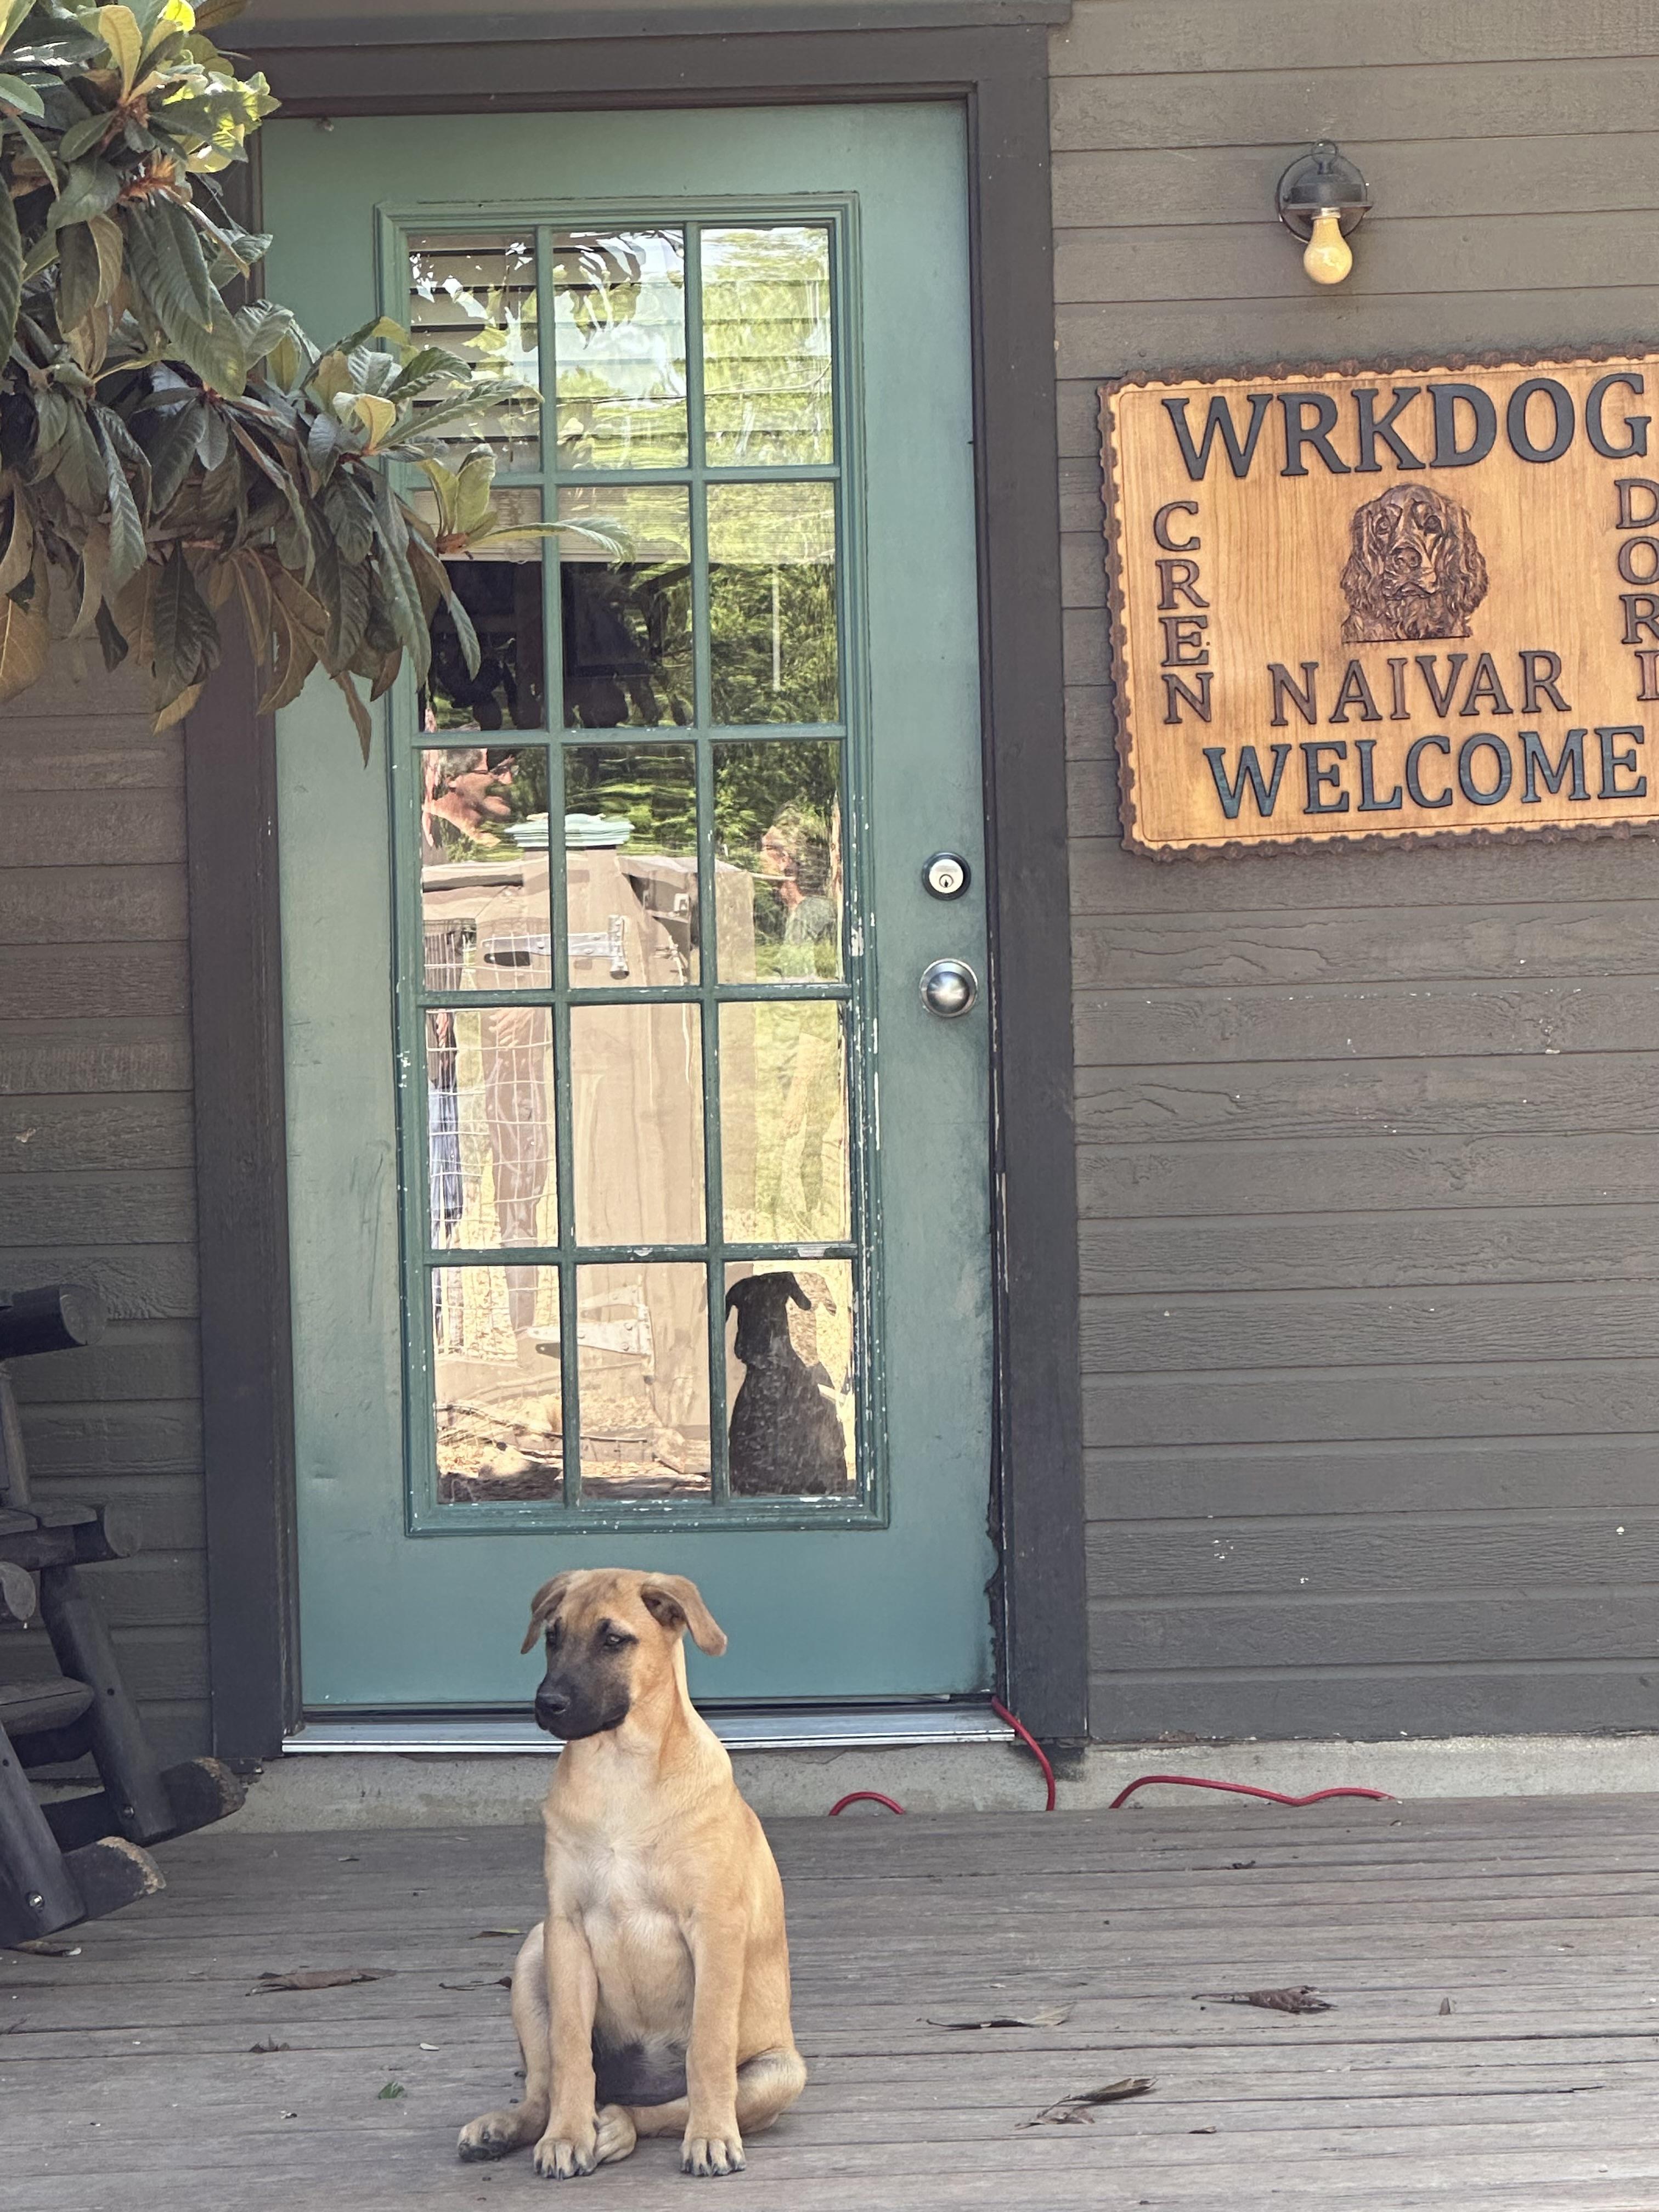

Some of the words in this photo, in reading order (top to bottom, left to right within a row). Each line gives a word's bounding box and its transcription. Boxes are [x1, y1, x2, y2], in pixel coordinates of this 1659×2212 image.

[1161, 373, 1652, 481] WRKDOG
[1153, 500, 1215, 725] CREN
[1267, 650, 1571, 726] NAIVAR
[1203, 725, 1647, 819] WELCOME
